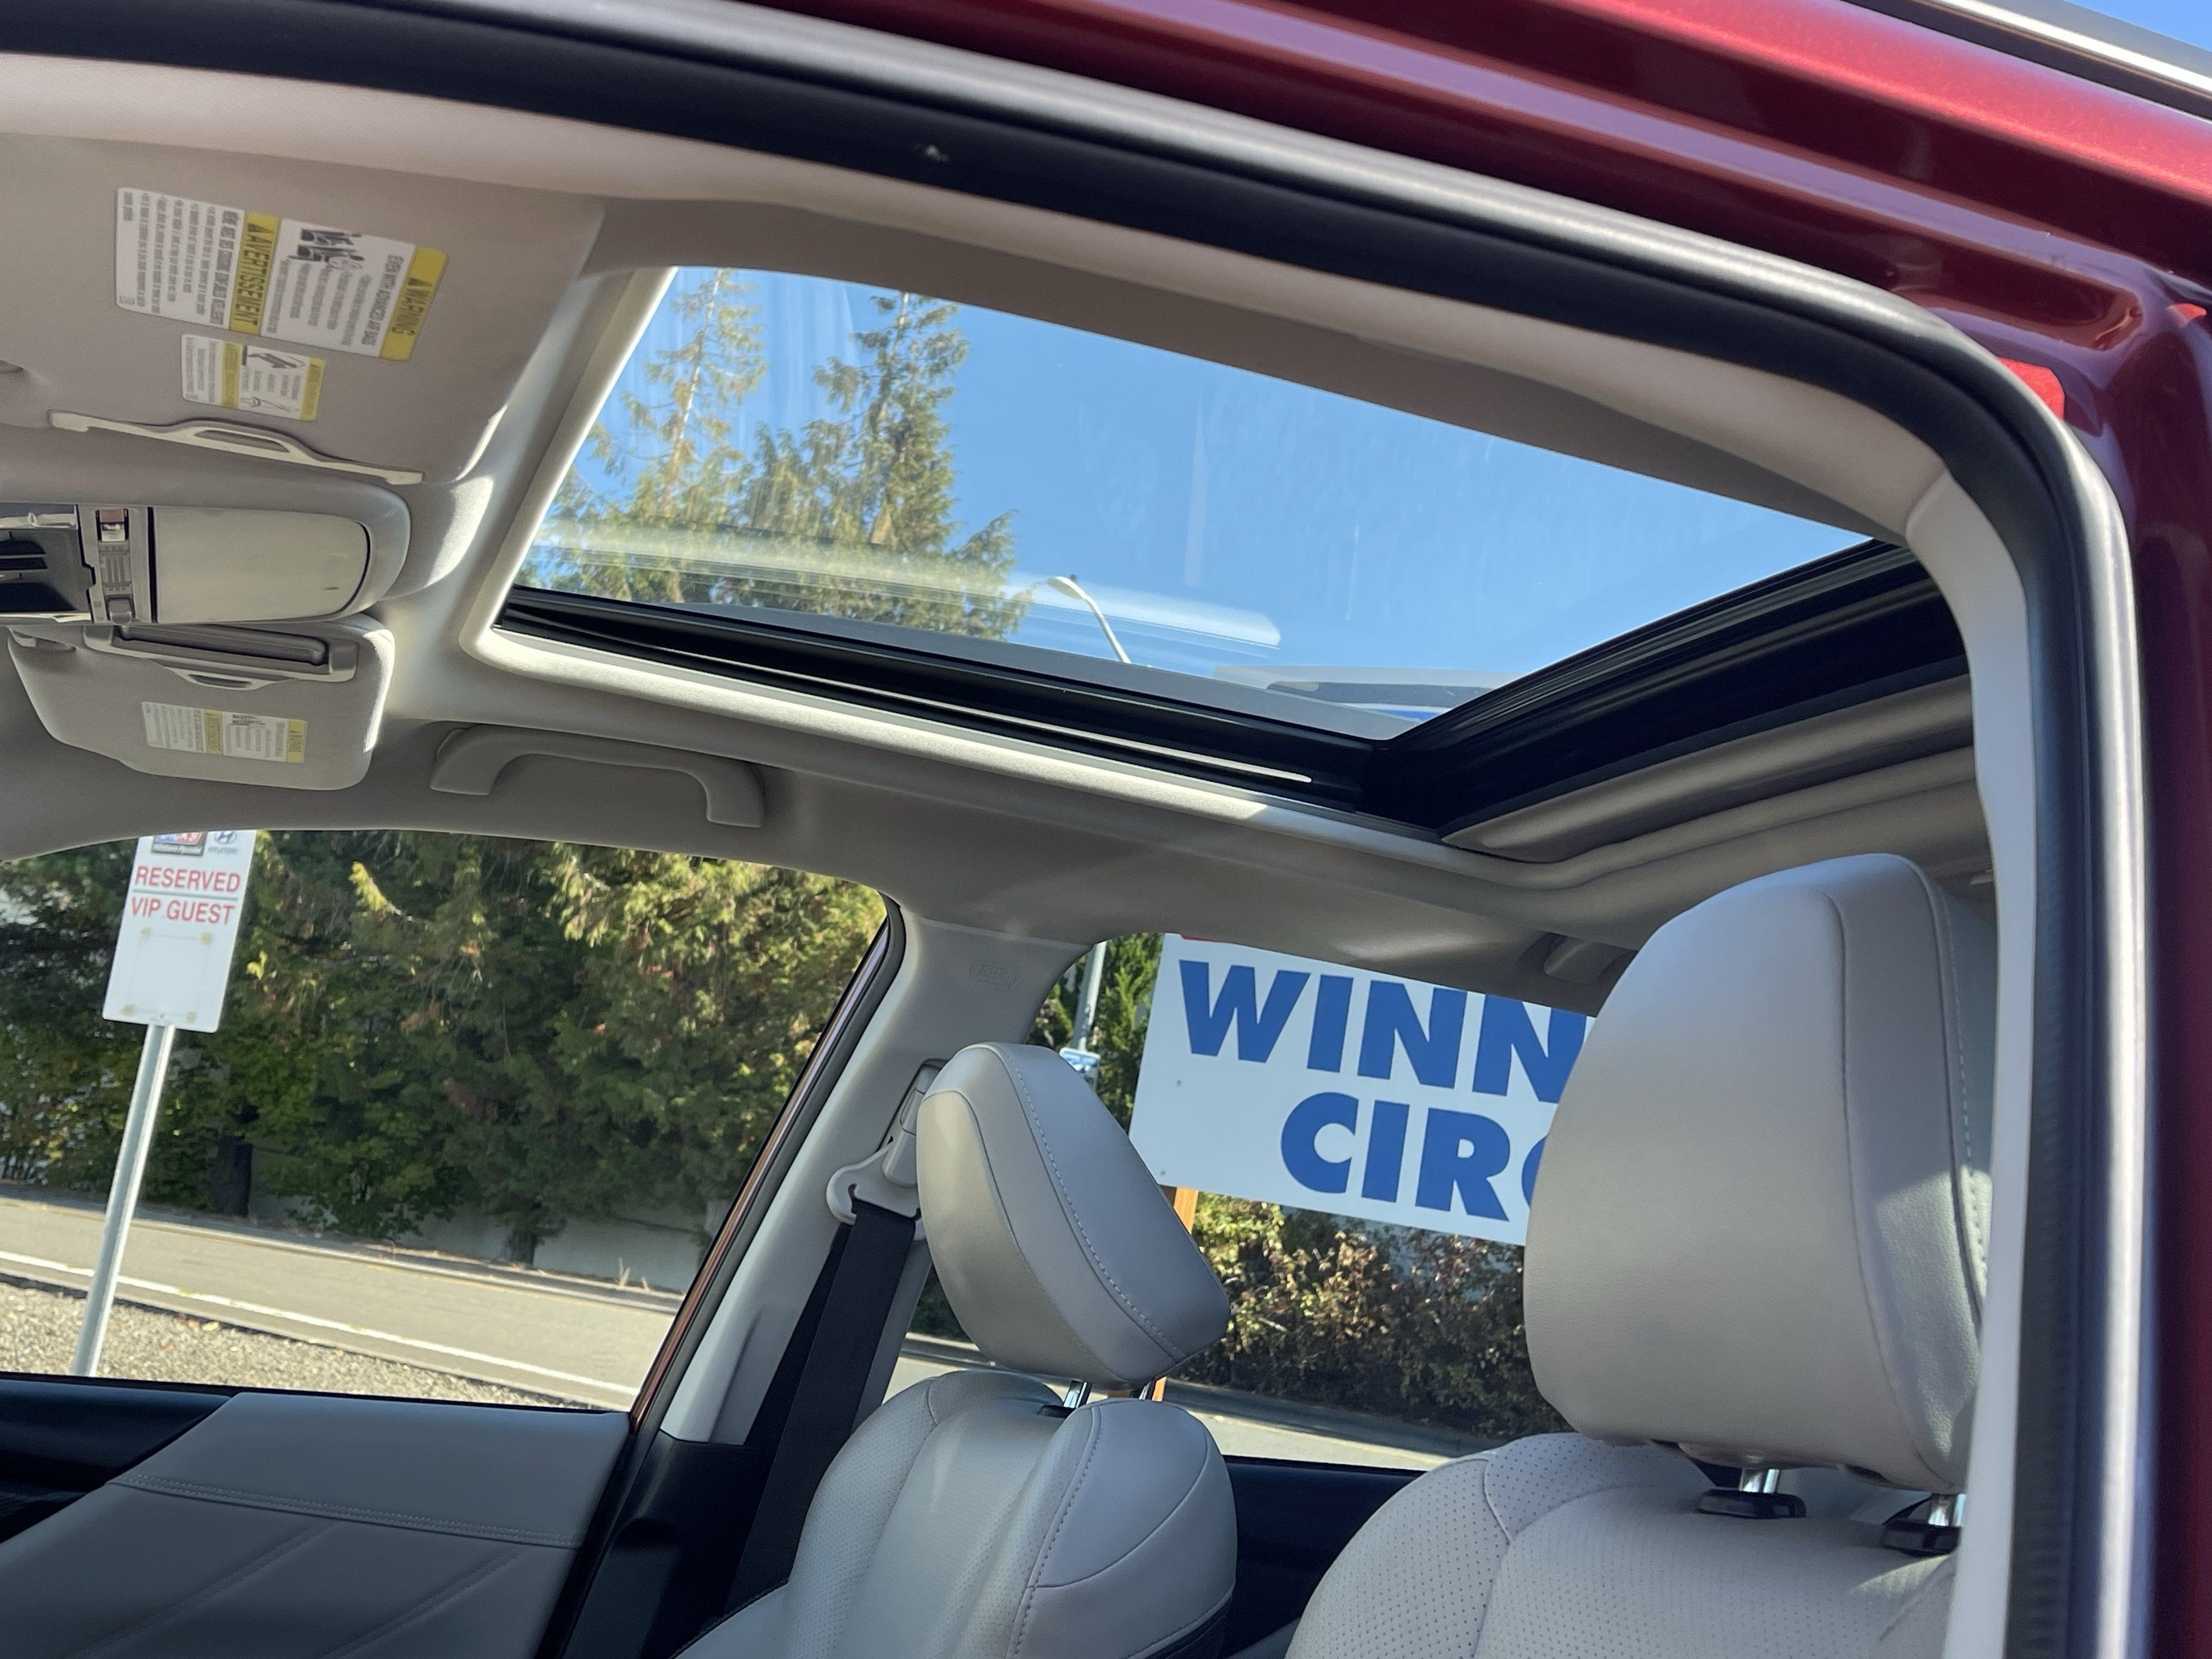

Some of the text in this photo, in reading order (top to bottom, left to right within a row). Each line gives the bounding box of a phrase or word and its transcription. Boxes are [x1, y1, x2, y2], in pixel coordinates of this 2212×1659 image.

[233, 234, 272, 325] AVERTISSEMENT
[391, 287, 430, 337] WARNING
[134, 865, 240, 893] RESERVED
[131, 896, 235, 925] VIP GUEST
[1281, 1091, 1547, 1221] CIR
